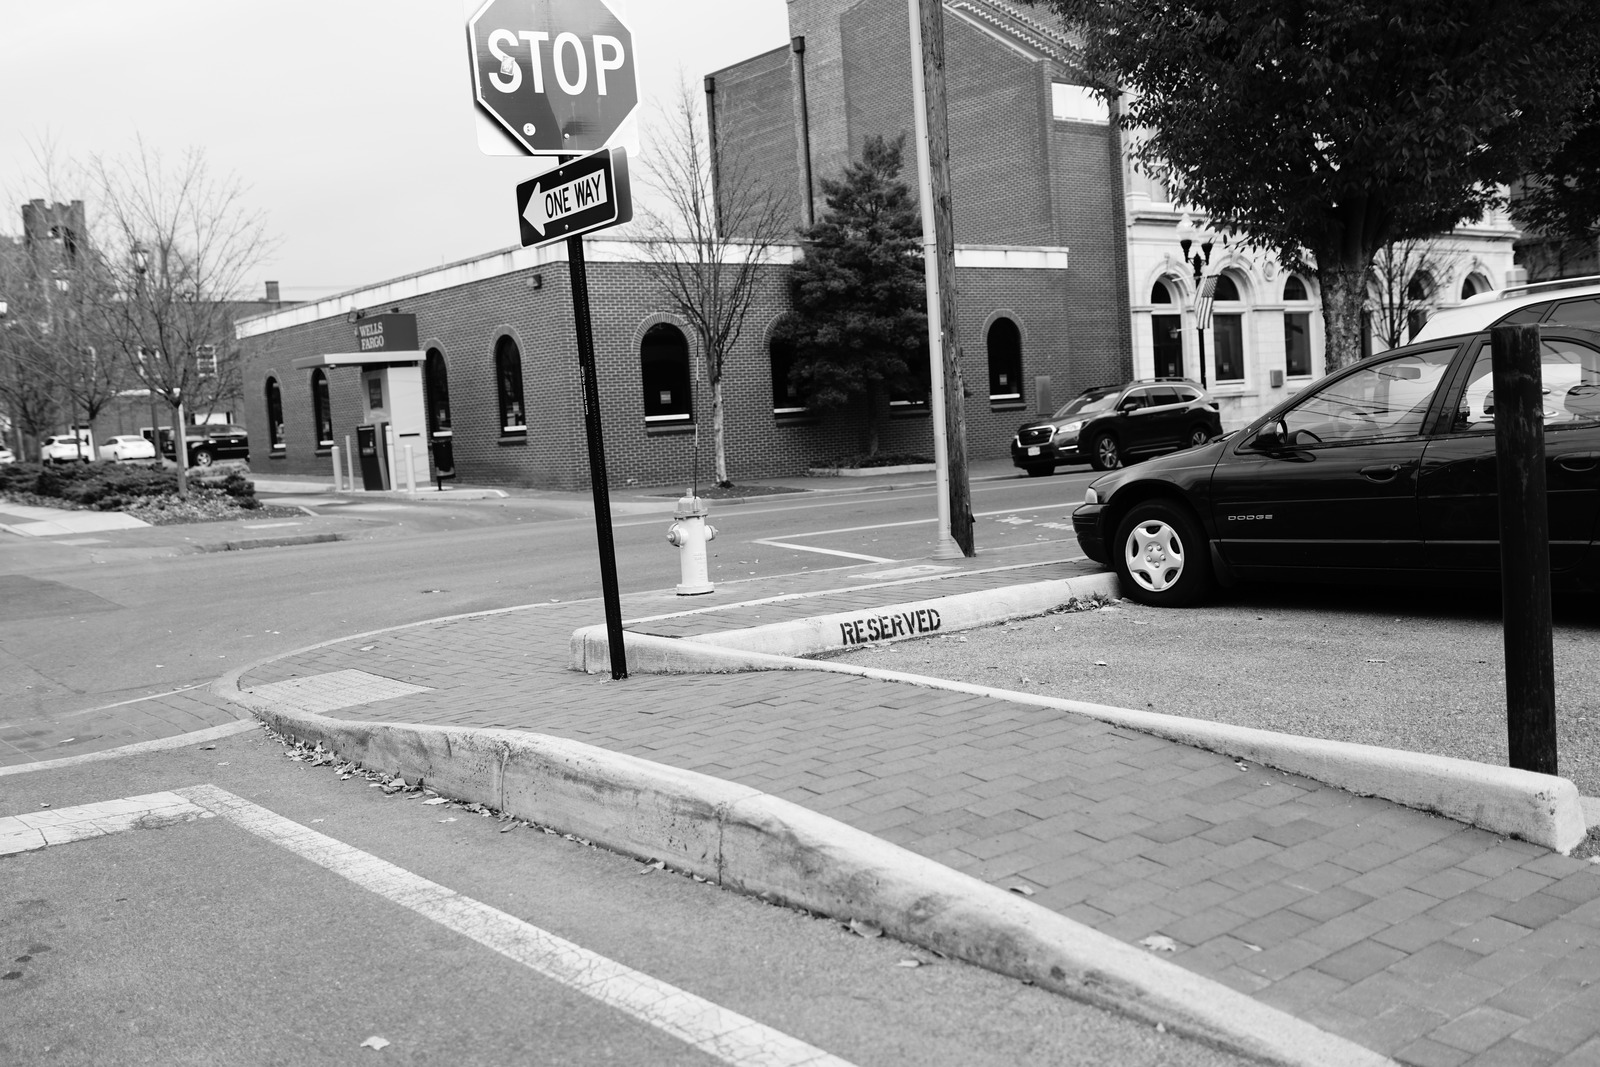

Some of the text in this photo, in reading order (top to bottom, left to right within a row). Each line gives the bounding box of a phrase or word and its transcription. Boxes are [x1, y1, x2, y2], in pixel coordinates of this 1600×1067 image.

[488, 29, 625, 96] STOP
[545, 174, 601, 219] ONE WAY
[359, 322, 383, 336] WELLS
[361, 335, 384, 350] FARGO
[840, 609, 941, 645] RESERVED
